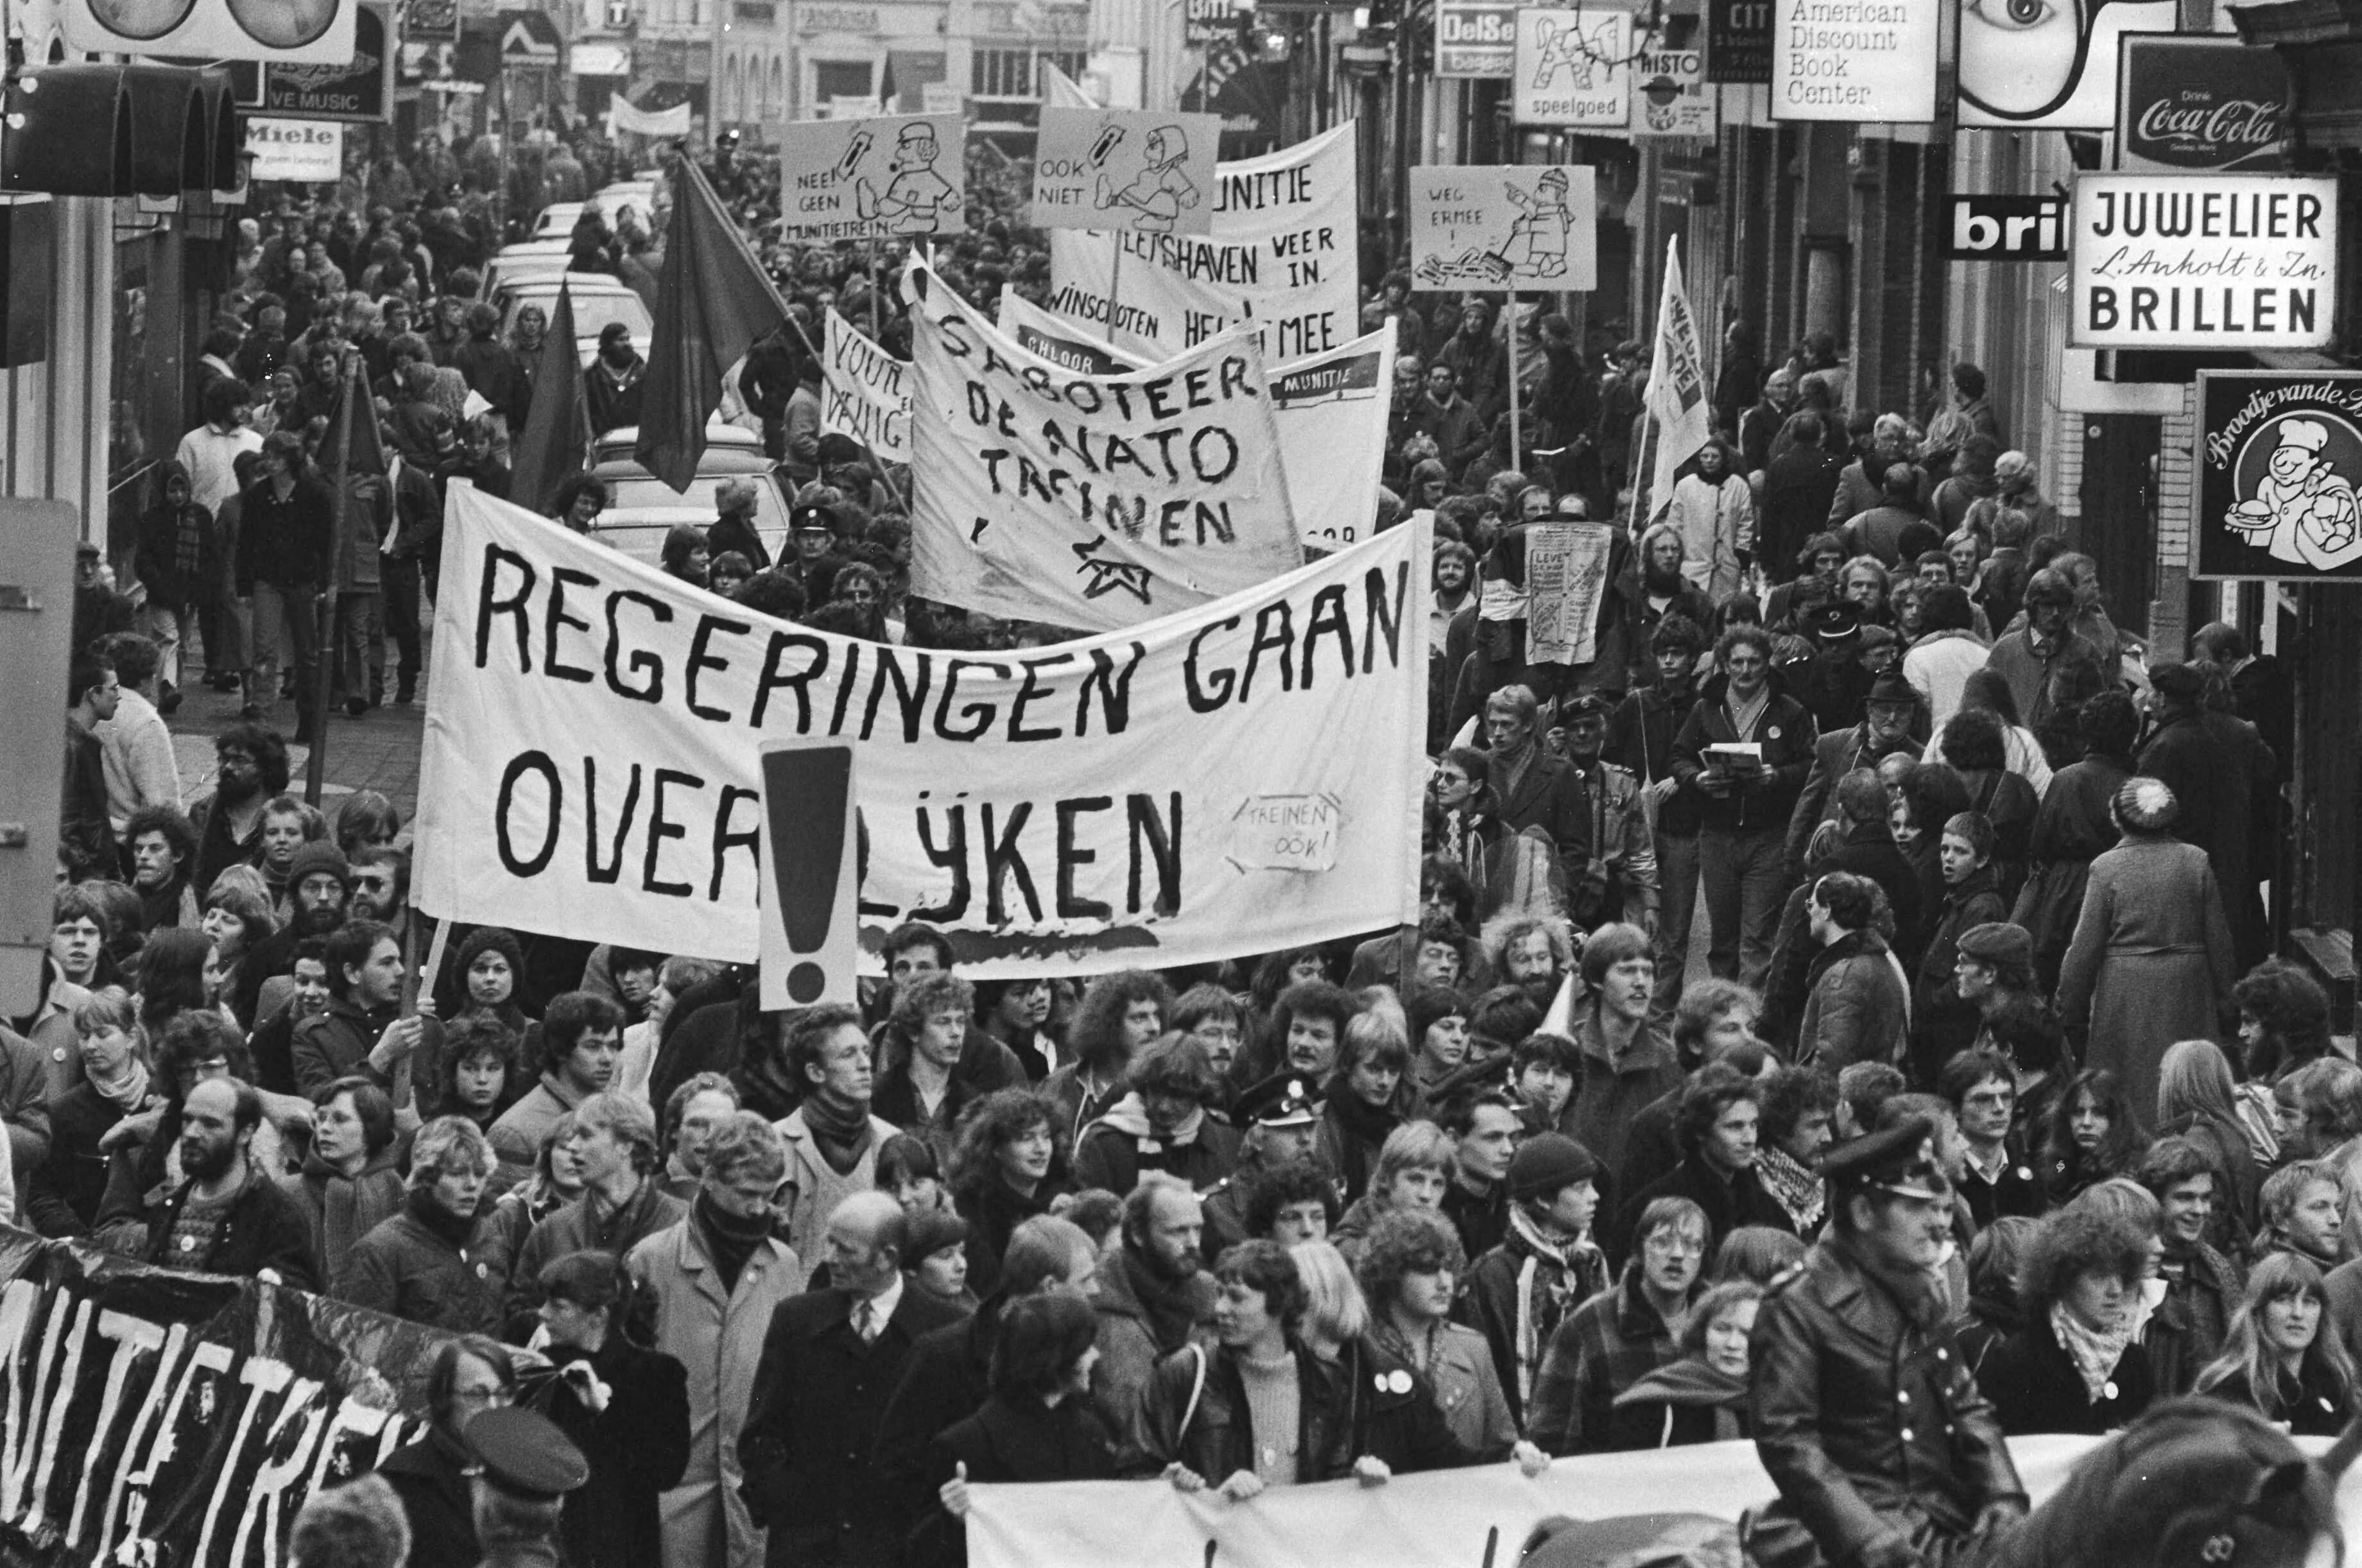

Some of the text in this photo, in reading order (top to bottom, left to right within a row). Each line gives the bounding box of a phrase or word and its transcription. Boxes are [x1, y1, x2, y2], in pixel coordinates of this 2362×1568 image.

[1790, 0, 1907, 22] American
[1444, 13, 1515, 41] DelSe
[1790, 26, 1897, 49] Discount
[1789, 53, 1849, 76] Book
[300, 93, 359, 110] MUSIC
[1788, 80, 1871, 104] Center
[1531, 97, 1617, 118] speelgoed
[2137, 98, 2280, 142] Coca-Cola
[247, 126, 334, 144] Miele
[797, 168, 836, 189] NEE!
[1040, 159, 1087, 178] OOK
[1039, 187, 1085, 205] NIET
[1212, 164, 1312, 211] UNITIE
[799, 195, 840, 212] GEEN
[2092, 192, 2322, 238] JUWELIER
[786, 220, 889, 240] MUNITIETREIN
[1431, 210, 1483, 227] ERMEE
[1273, 227, 1334, 257] VEER
[2254, 257, 2268, 276] &
[2089, 286, 2315, 332] BRILLEN
[938, 314, 1260, 421] SABOTEER
[1284, 368, 1351, 393] MUNITIE
[1042, 417, 1239, 484] NATO
[979, 447, 1235, 547] TREINEN
[475, 542, 1410, 743] REGERINGEN GAAN
[1250, 804, 1327, 826] TREINEN
